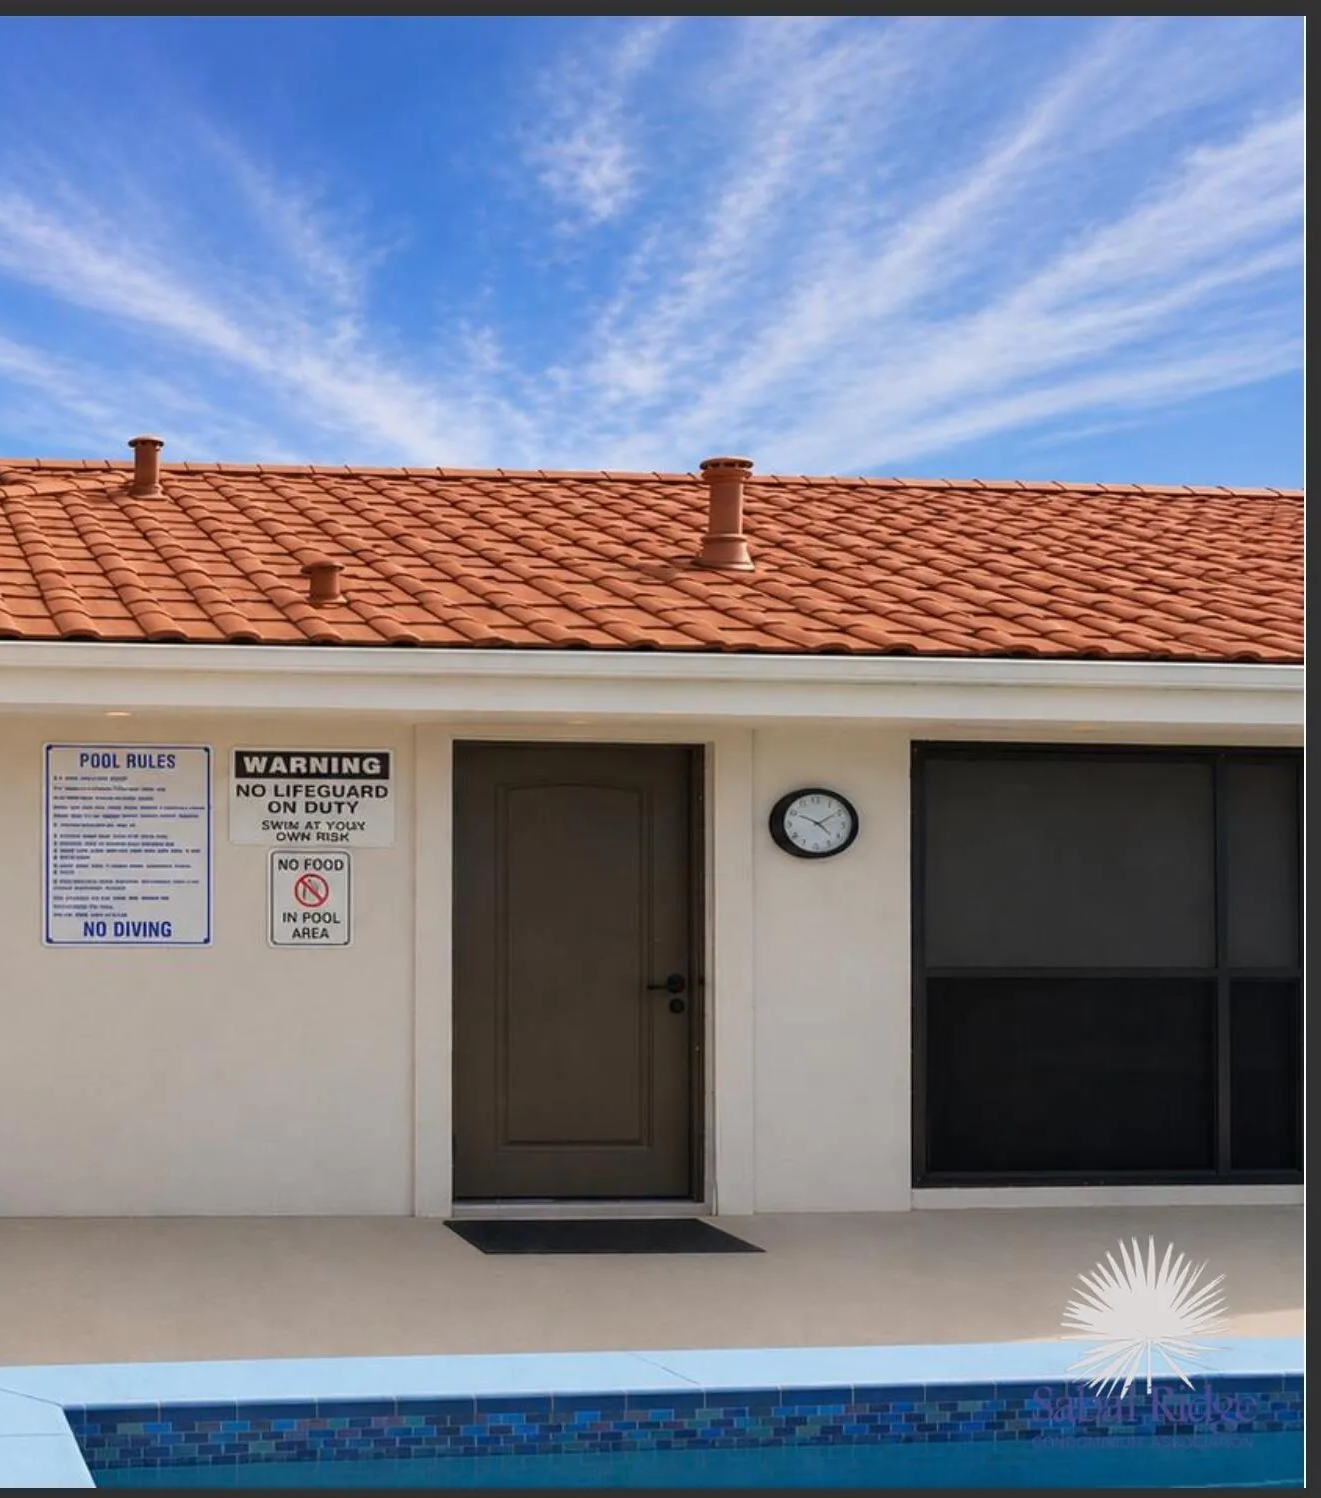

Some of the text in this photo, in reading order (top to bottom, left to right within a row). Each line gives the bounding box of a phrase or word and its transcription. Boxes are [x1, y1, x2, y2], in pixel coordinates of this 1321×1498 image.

[80, 752, 176, 769] POOL RULES
[243, 756, 381, 774] WARNING
[236, 784, 388, 799] NO LIFEGUARD
[267, 801, 359, 814] ON DUTY
[304, 821, 321, 830] AT
[276, 832, 350, 842] OWN RISK
[278, 859, 344, 871] NO FOOD
[282, 912, 340, 924] IN POOL
[83, 921, 172, 938] NO DIVING
[292, 928, 330, 939] AREA
